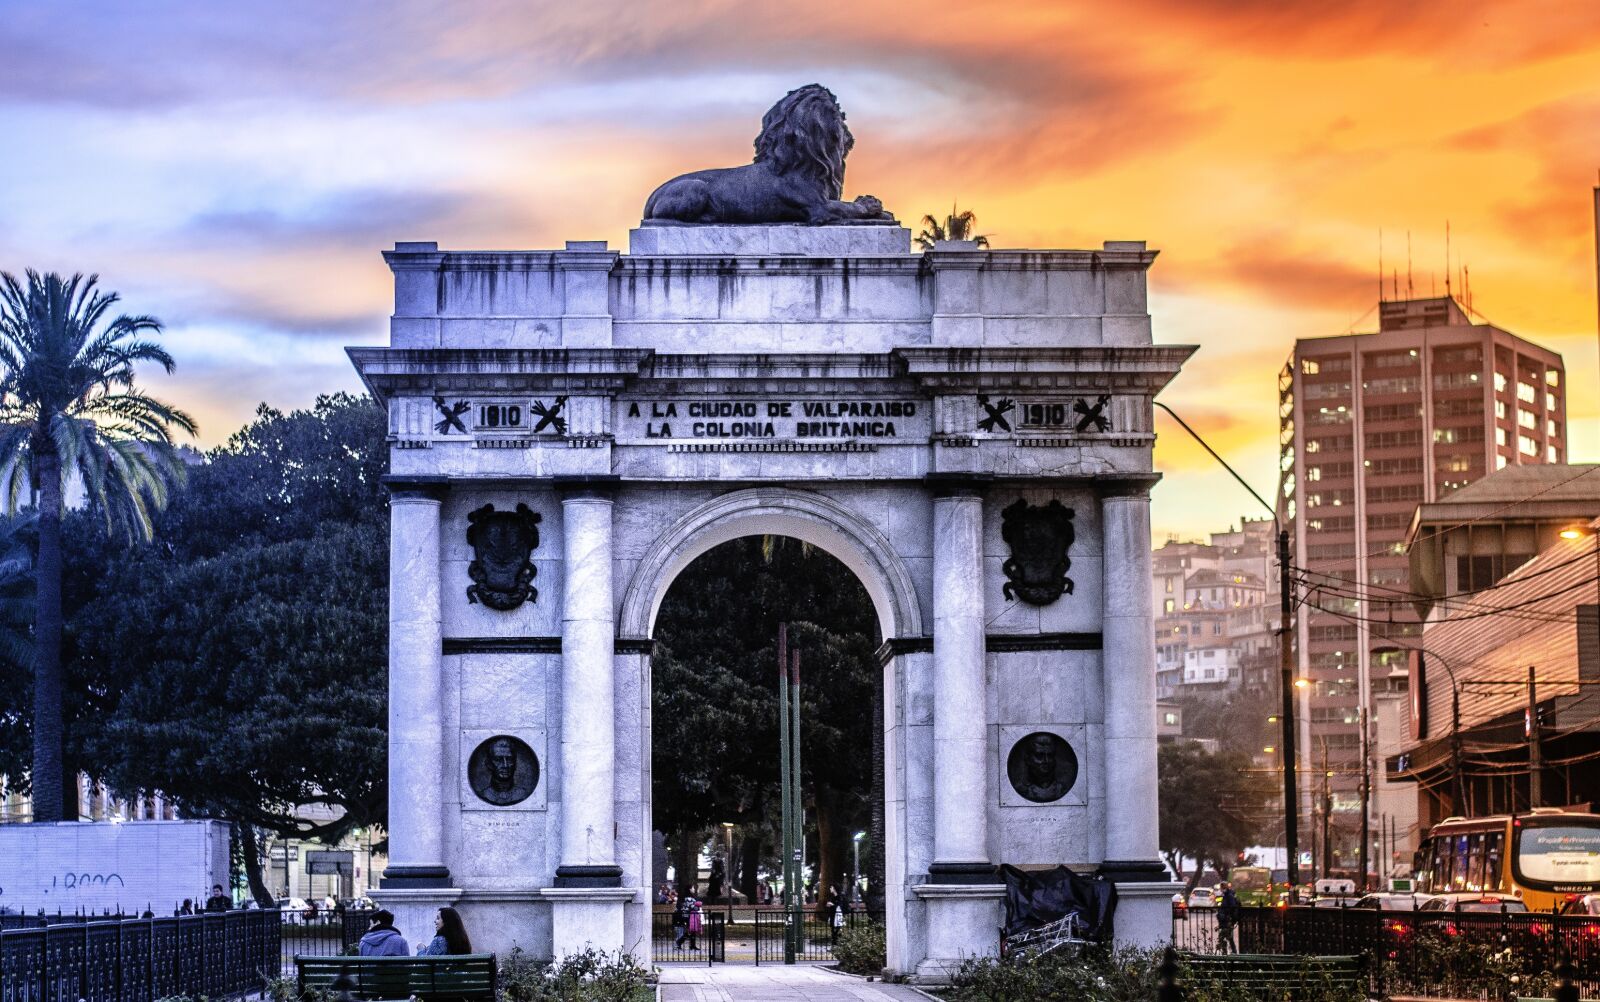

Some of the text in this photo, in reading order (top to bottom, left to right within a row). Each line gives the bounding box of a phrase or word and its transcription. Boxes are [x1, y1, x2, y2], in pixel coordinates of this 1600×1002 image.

[480, 405, 521, 426] 1810
[628, 401, 916, 418] A LA CIUDAD DE VALPARAISO
[1023, 403, 1065, 425] 1910
[646, 422, 896, 438] LA COLONIA BRITANICA
